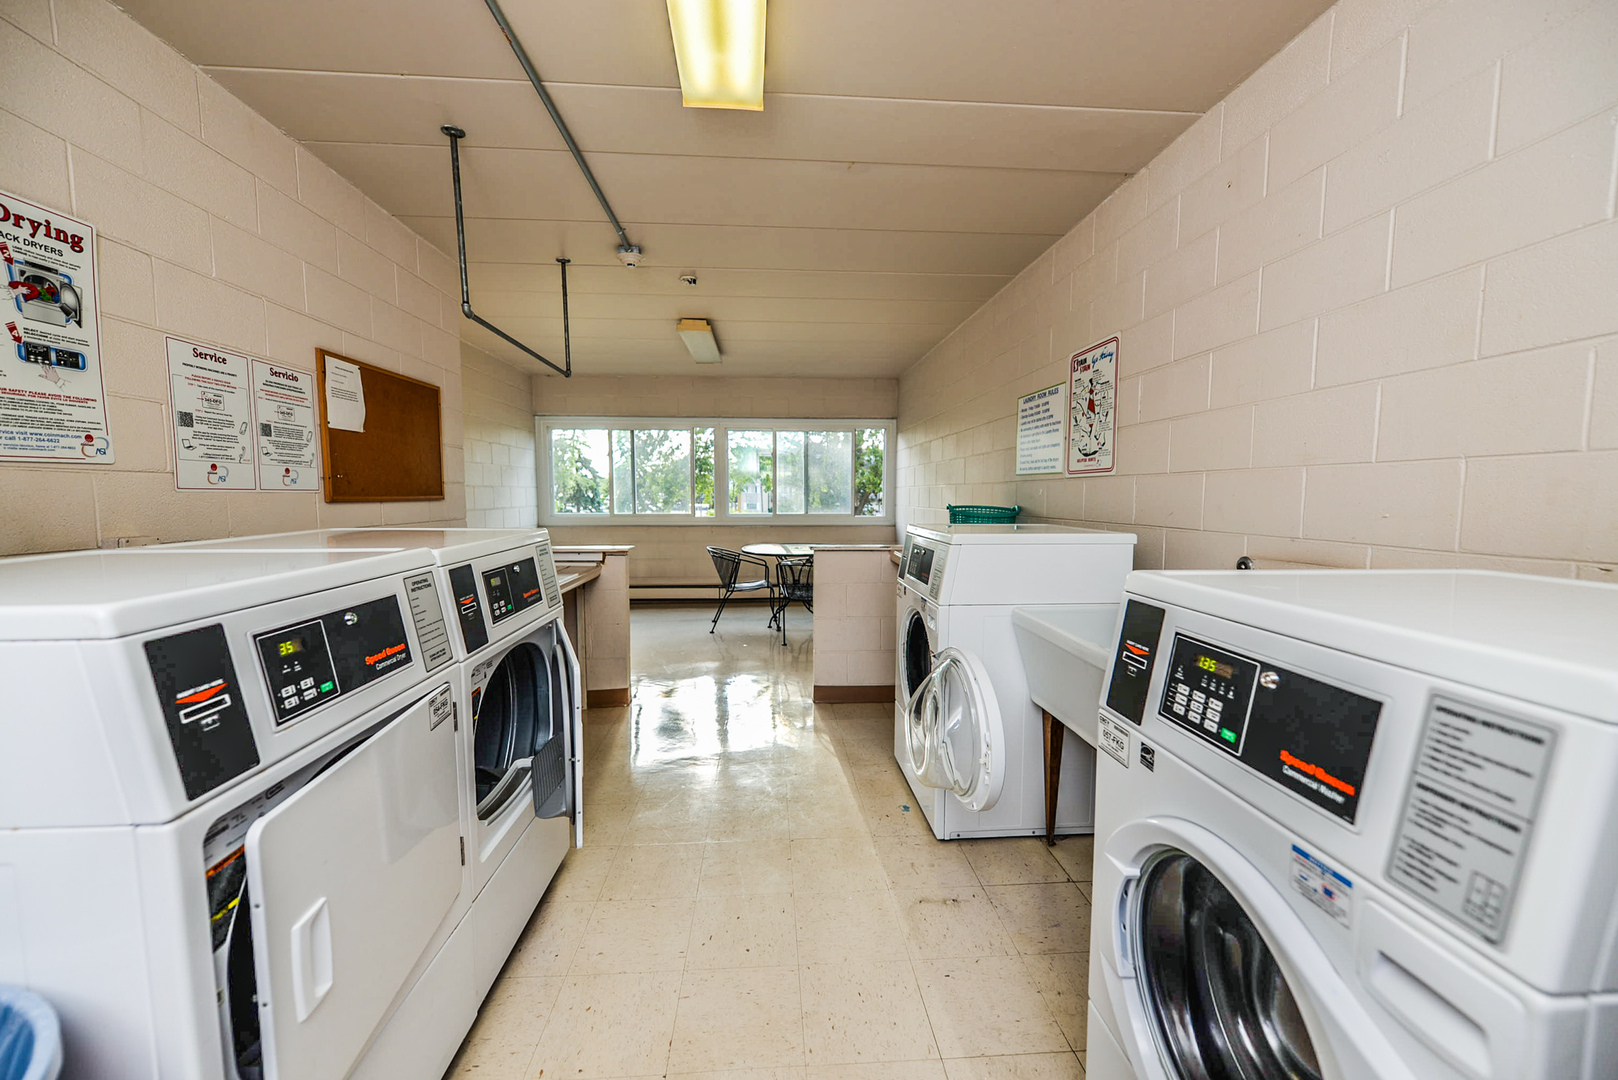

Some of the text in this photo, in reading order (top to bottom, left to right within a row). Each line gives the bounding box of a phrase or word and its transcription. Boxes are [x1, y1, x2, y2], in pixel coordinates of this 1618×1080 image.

[23, 238, 63, 257] DRYERS
[192, 348, 227, 364] Service
[270, 367, 298, 382] Servicio
[1048, 387, 1059, 396] RULES
[411, 583, 432, 593] INSTRUCTIONS
[412, 578, 428, 586] OPERATING
[279, 641, 294, 656] 35
[365, 650, 386, 665] Speed
[376, 656, 396, 670] Commercial
